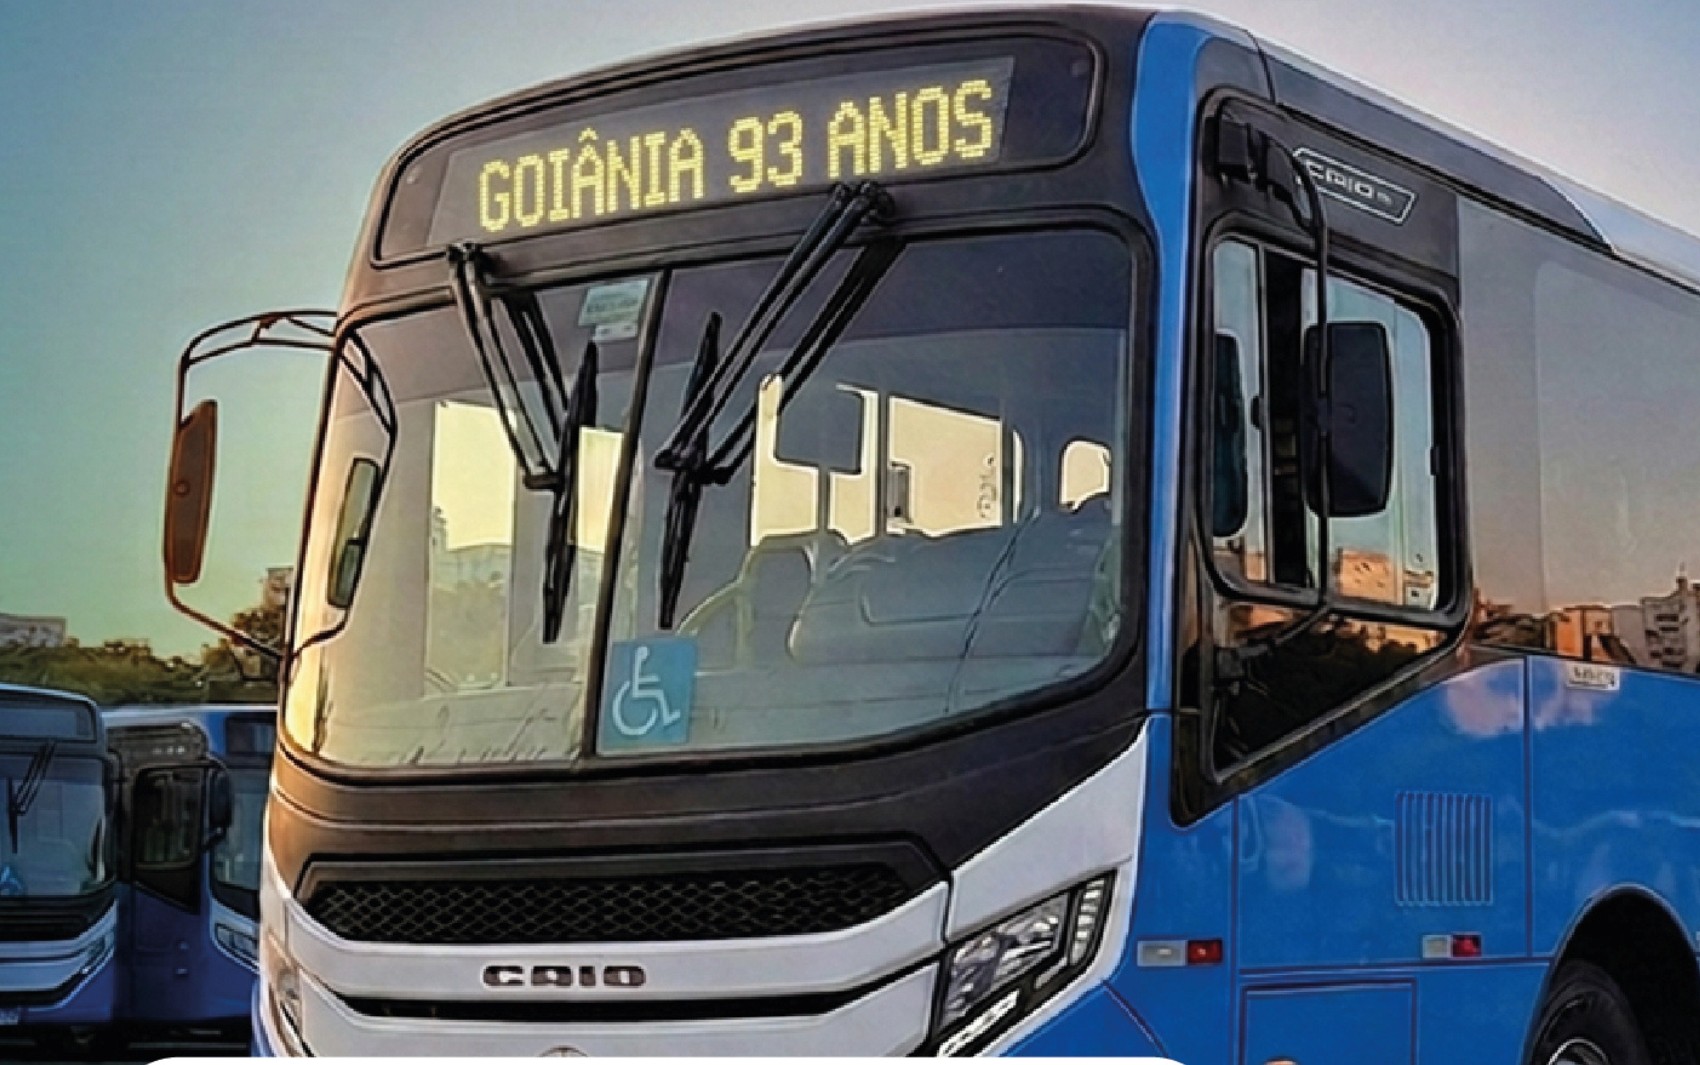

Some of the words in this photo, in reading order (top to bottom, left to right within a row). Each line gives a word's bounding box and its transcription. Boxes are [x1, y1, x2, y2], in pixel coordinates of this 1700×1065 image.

[479, 127, 704, 232] GOIÂNIA
[727, 110, 802, 193] 93
[827, 79, 992, 178] ANOS
[483, 965, 646, 987] CAIO
